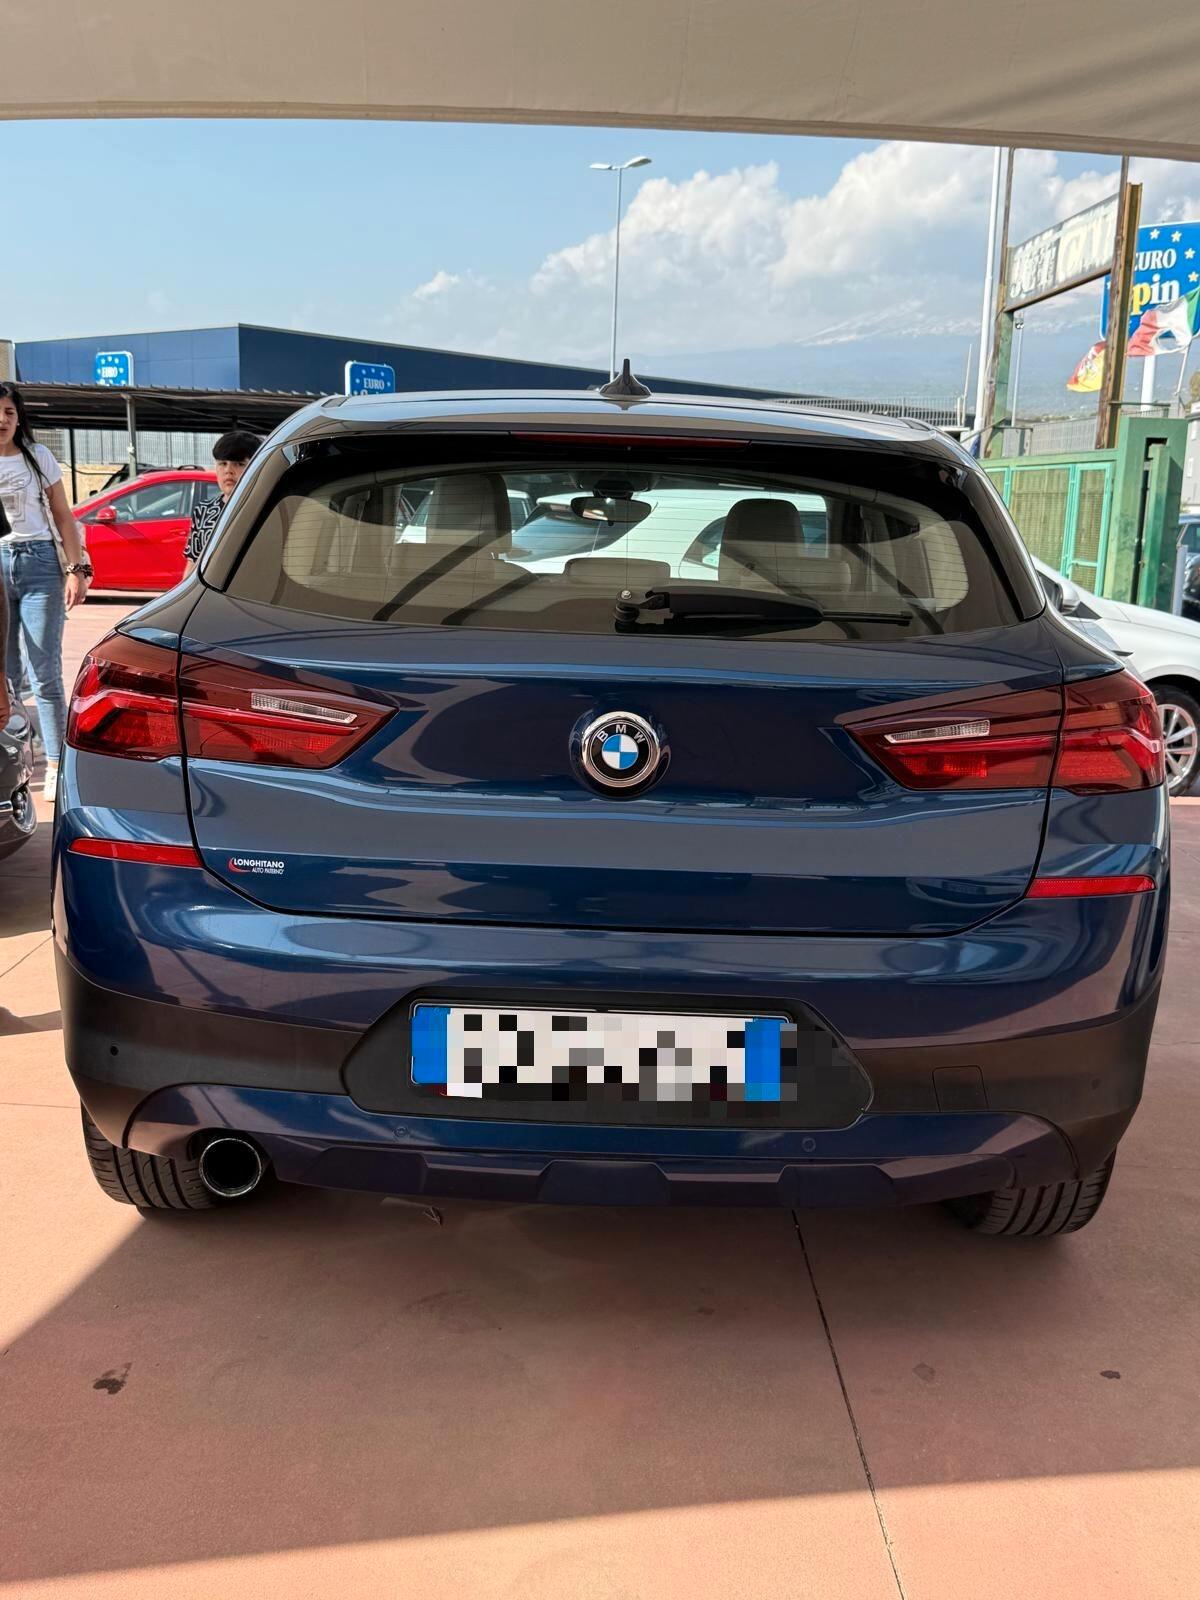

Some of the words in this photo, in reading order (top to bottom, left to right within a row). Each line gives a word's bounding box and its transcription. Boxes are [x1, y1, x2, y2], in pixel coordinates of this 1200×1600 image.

[1130, 273, 1180, 316] pin
[363, 377, 385, 390] EURO
[596, 724, 646, 744] BMW
[233, 858, 284, 868] LONGHITANO
